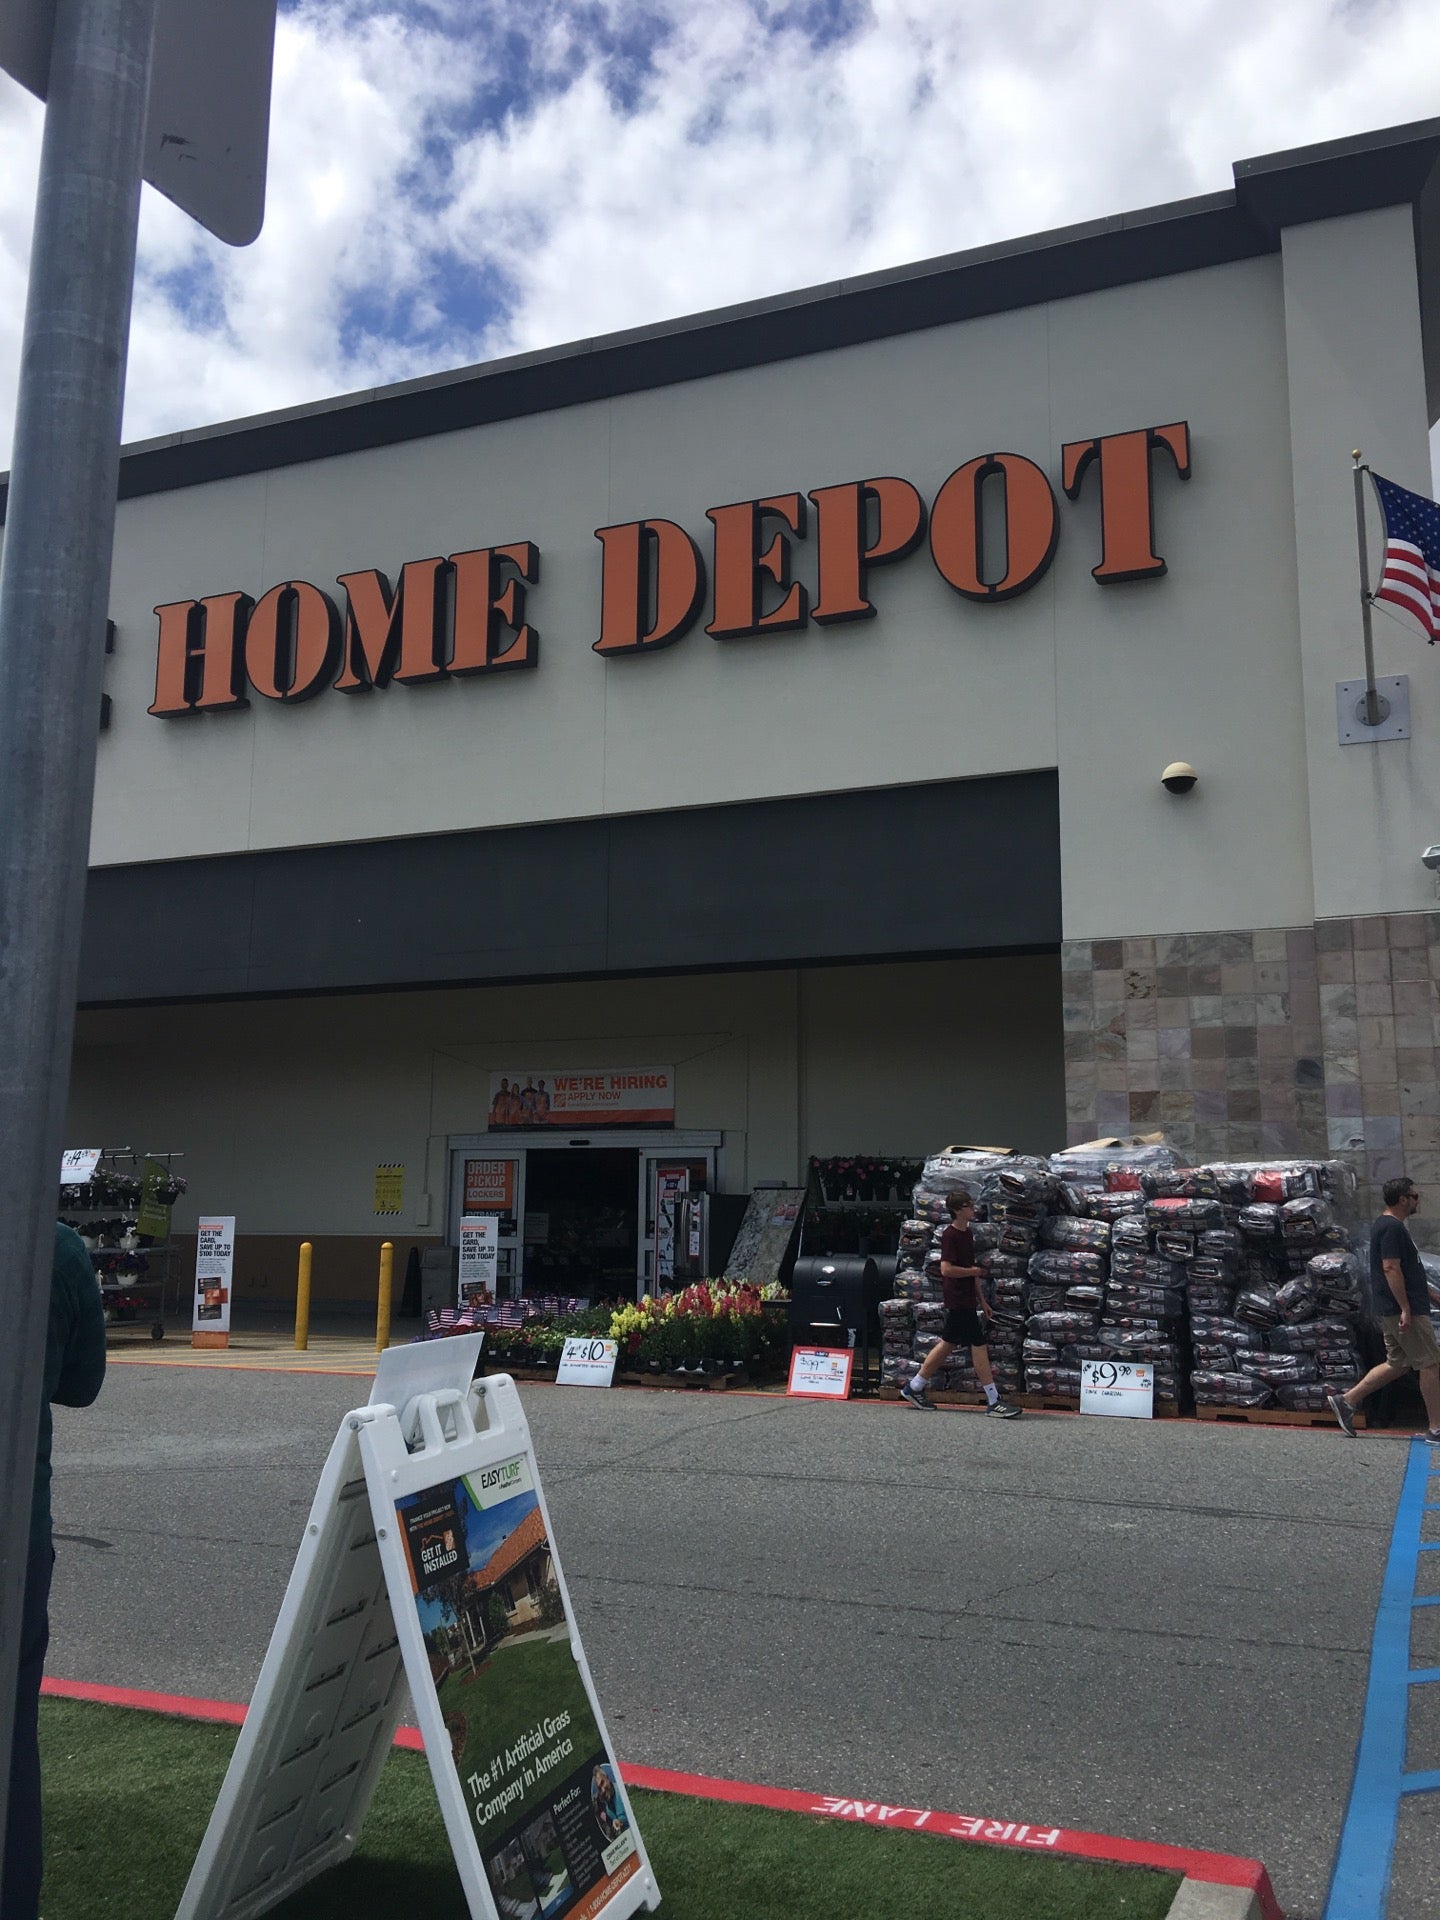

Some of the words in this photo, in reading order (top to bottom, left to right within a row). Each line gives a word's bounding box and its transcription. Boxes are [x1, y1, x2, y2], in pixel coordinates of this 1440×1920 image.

[147, 541, 540, 719] HOME
[592, 420, 1192, 657] DEPOT
[553, 1076, 605, 1091] WE'RE
[610, 1074, 668, 1090] HIRING
[568, 1092, 596, 1101] APPLY
[598, 1091, 621, 1100] NOW
[467, 1161, 506, 1175] ORDER
[467, 1175, 506, 1187] PICKUP
[468, 1190, 504, 1198] LOCKERS
[462, 1231, 474, 1239] GET
[477, 1252, 495, 1260] TODAY
[567, 1346, 577, 1359] 4
[581, 1341, 605, 1361] $10
[421, 1547, 434, 1562] GET
[435, 1544, 442, 1556] IT
[423, 1550, 458, 1575] INSTALLED
[467, 1771, 491, 1798] The
[490, 1756, 505, 1782] #1
[505, 1723, 545, 1773] Artificial
[543, 1710, 571, 1738] Grass
[475, 1773, 525, 1826] Company
[522, 1767, 532, 1788] in
[535, 1738, 573, 1780] America
[552, 1794, 571, 1815] Perfect
[570, 1786, 581, 1800] For:
[811, 1796, 932, 1827] LANE
[950, 1815, 1061, 1846] FIRE
